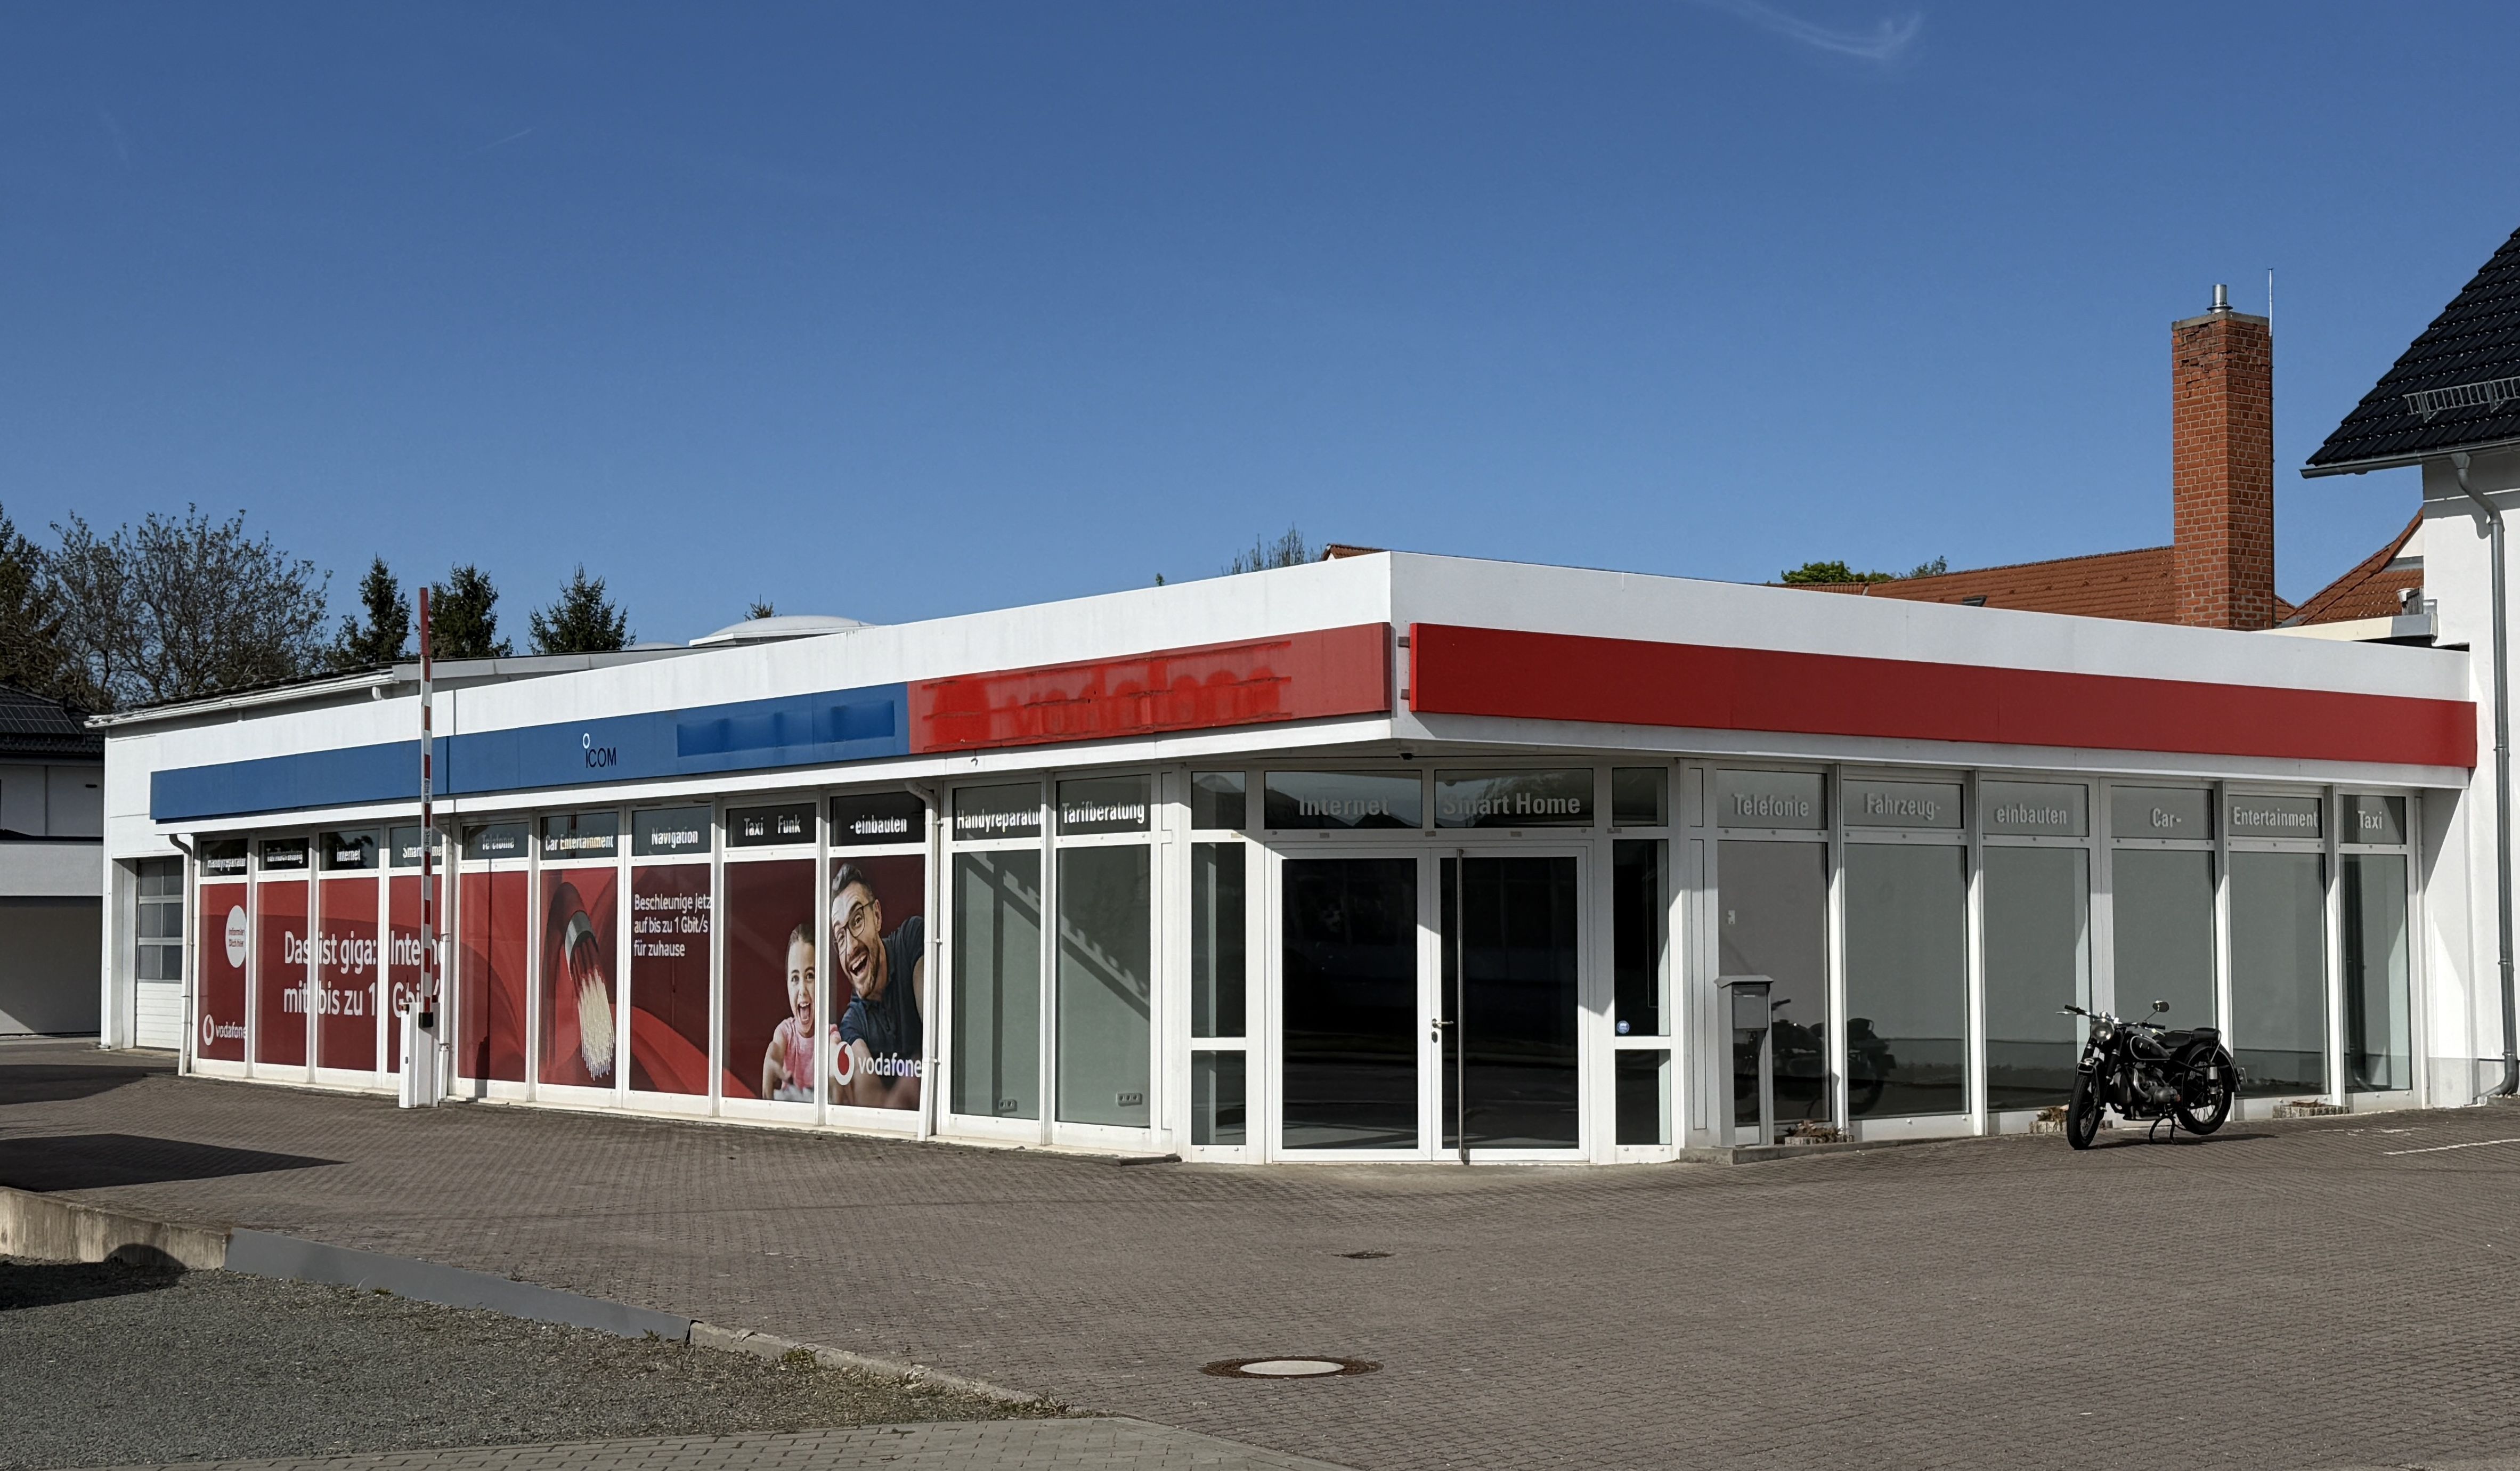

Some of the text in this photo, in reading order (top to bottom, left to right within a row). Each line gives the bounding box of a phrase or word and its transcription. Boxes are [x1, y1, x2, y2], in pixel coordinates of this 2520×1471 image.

[1062, 801, 1144, 824] Tarifberatung
[1299, 794, 1390, 816] Internet
[1443, 792, 1581, 816] Smart Home
[1733, 792, 1809, 817] Telefonie
[1866, 792, 1941, 820] Fahrzeug-
[1997, 803, 2067, 824] einbauten
[744, 814, 801, 836] Taxi Funk
[2152, 807, 2182, 827] Car-
[2234, 806, 2318, 828] Entertainment
[2358, 810, 2383, 830] Taxi
[545, 832, 614, 851] Car Entertainment
[651, 826, 698, 849] Navigation
[635, 892, 693, 914] Beschleunige
[634, 914, 709, 934] auf bis zu 1 Gbit/s
[284, 931, 308, 964] Das
[319, 931, 338, 965] ist
[340, 930, 377, 974] giga:
[634, 939, 686, 957] für zuhause
[283, 980, 308, 1013] mit
[318, 980, 340, 1015] bis
[344, 990, 363, 1016] zu
[368, 982, 376, 1017] 1
[858, 1052, 922, 1078] vodafone
